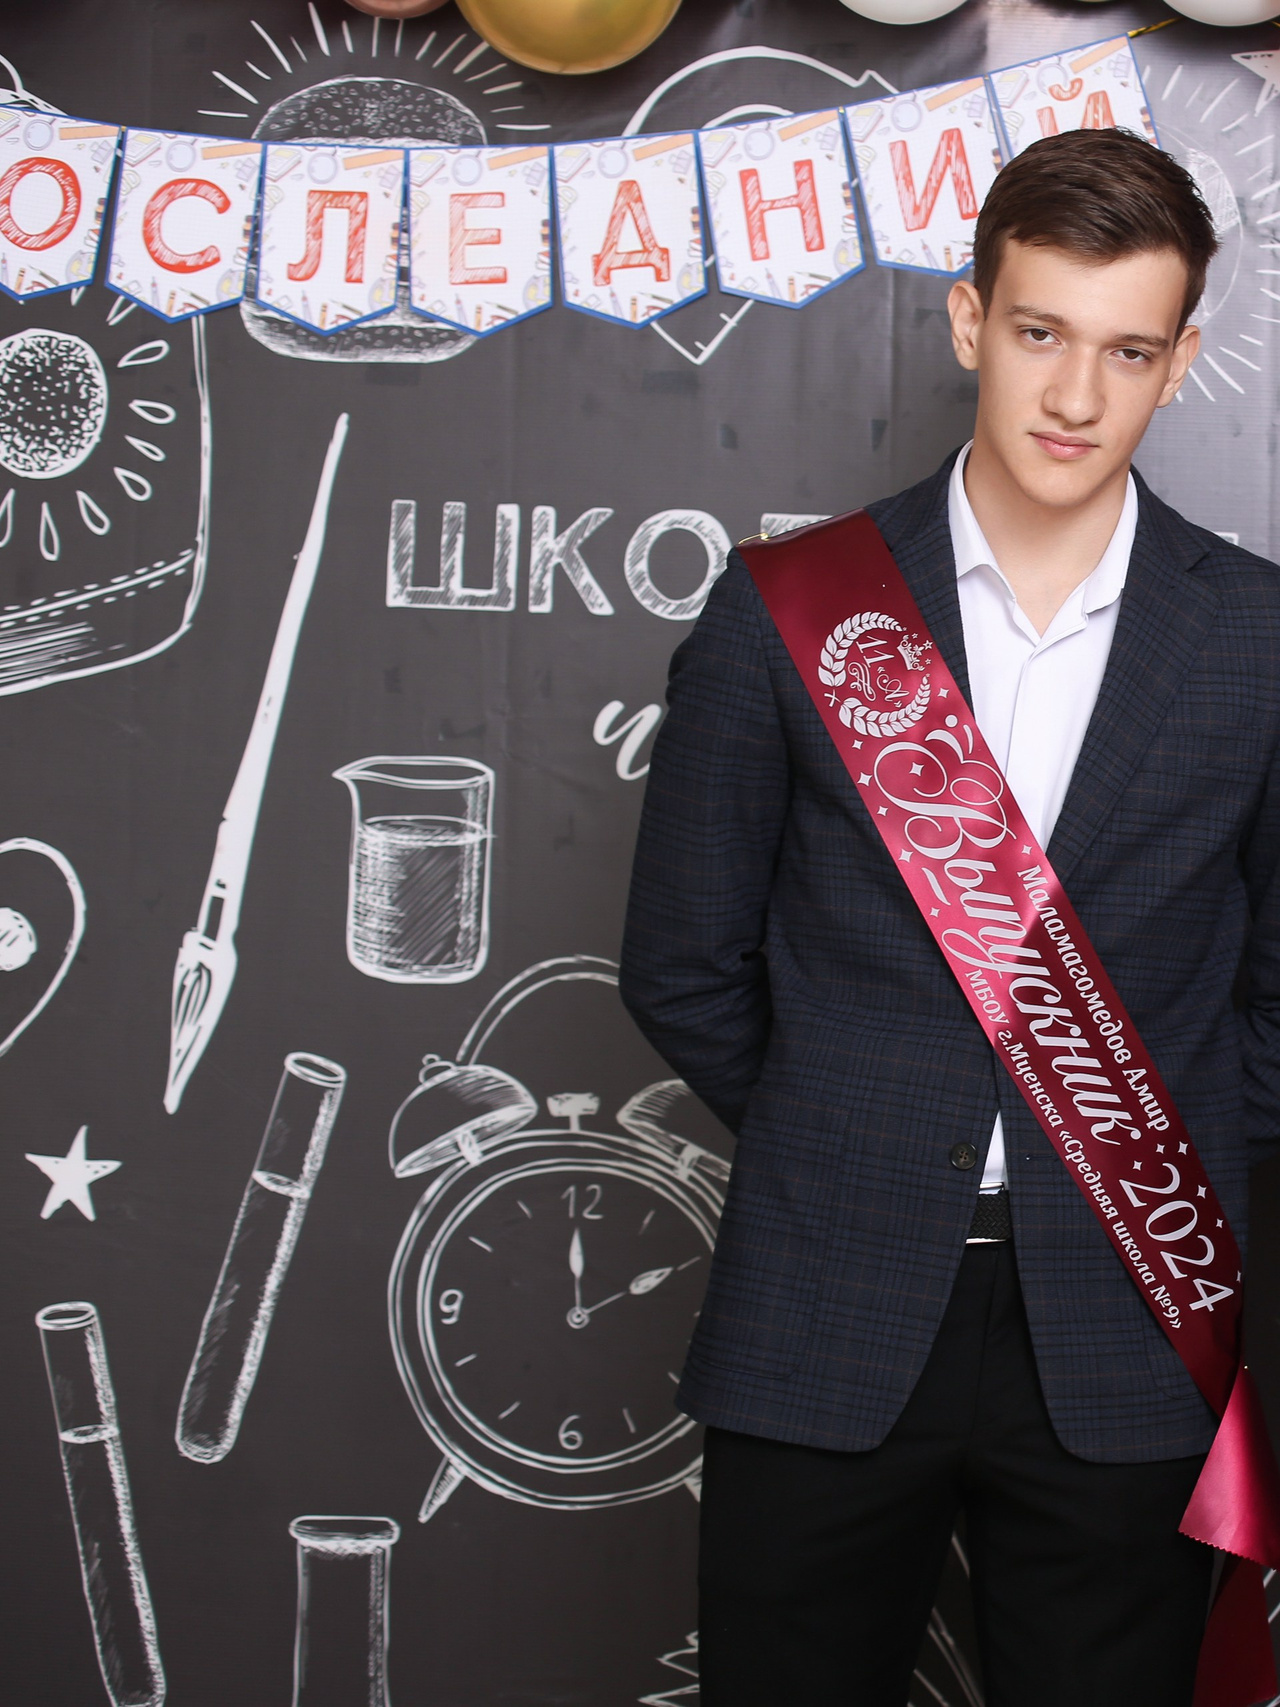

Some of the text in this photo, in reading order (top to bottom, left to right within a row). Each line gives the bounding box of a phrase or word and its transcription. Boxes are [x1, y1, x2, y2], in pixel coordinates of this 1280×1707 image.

[873, 728, 1235, 1312] Выпускник 2024
[1017, 865, 1170, 1132] Маламагомедов Амир
[560, 1184, 603, 1220] 12
[965, 969, 1011, 1024] МБОУ
[1059, 1129, 1119, 1220] «Средняя
[1112, 1220, 1157, 1285] школа
[1150, 1285, 1182, 1329] №9»
[439, 1289, 463, 1324] 9
[558, 1414, 583, 1450] 6
